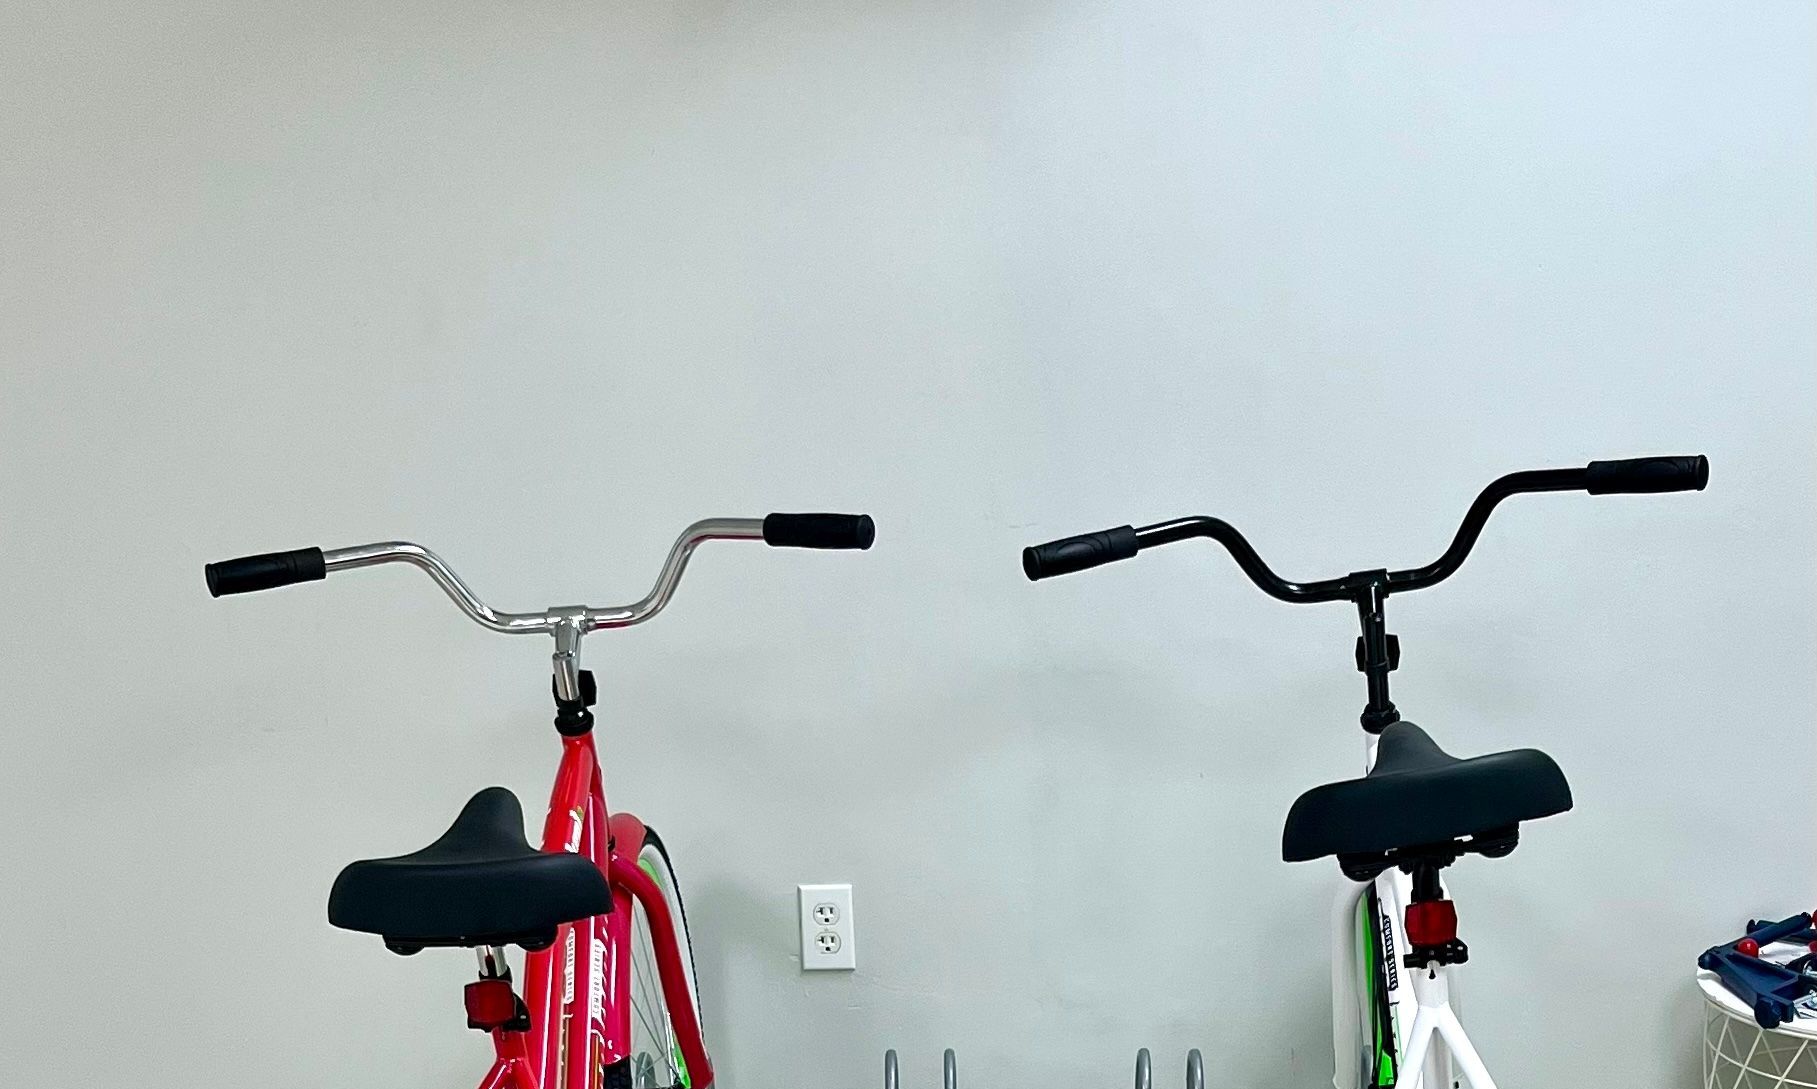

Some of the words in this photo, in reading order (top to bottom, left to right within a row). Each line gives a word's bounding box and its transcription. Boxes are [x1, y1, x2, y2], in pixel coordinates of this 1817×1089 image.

[1384, 917, 1394, 956] COMFORT
[593, 943, 602, 973] SERIES
[1388, 957, 1398, 989] SERIES
[592, 976, 600, 1014] COMFORT
